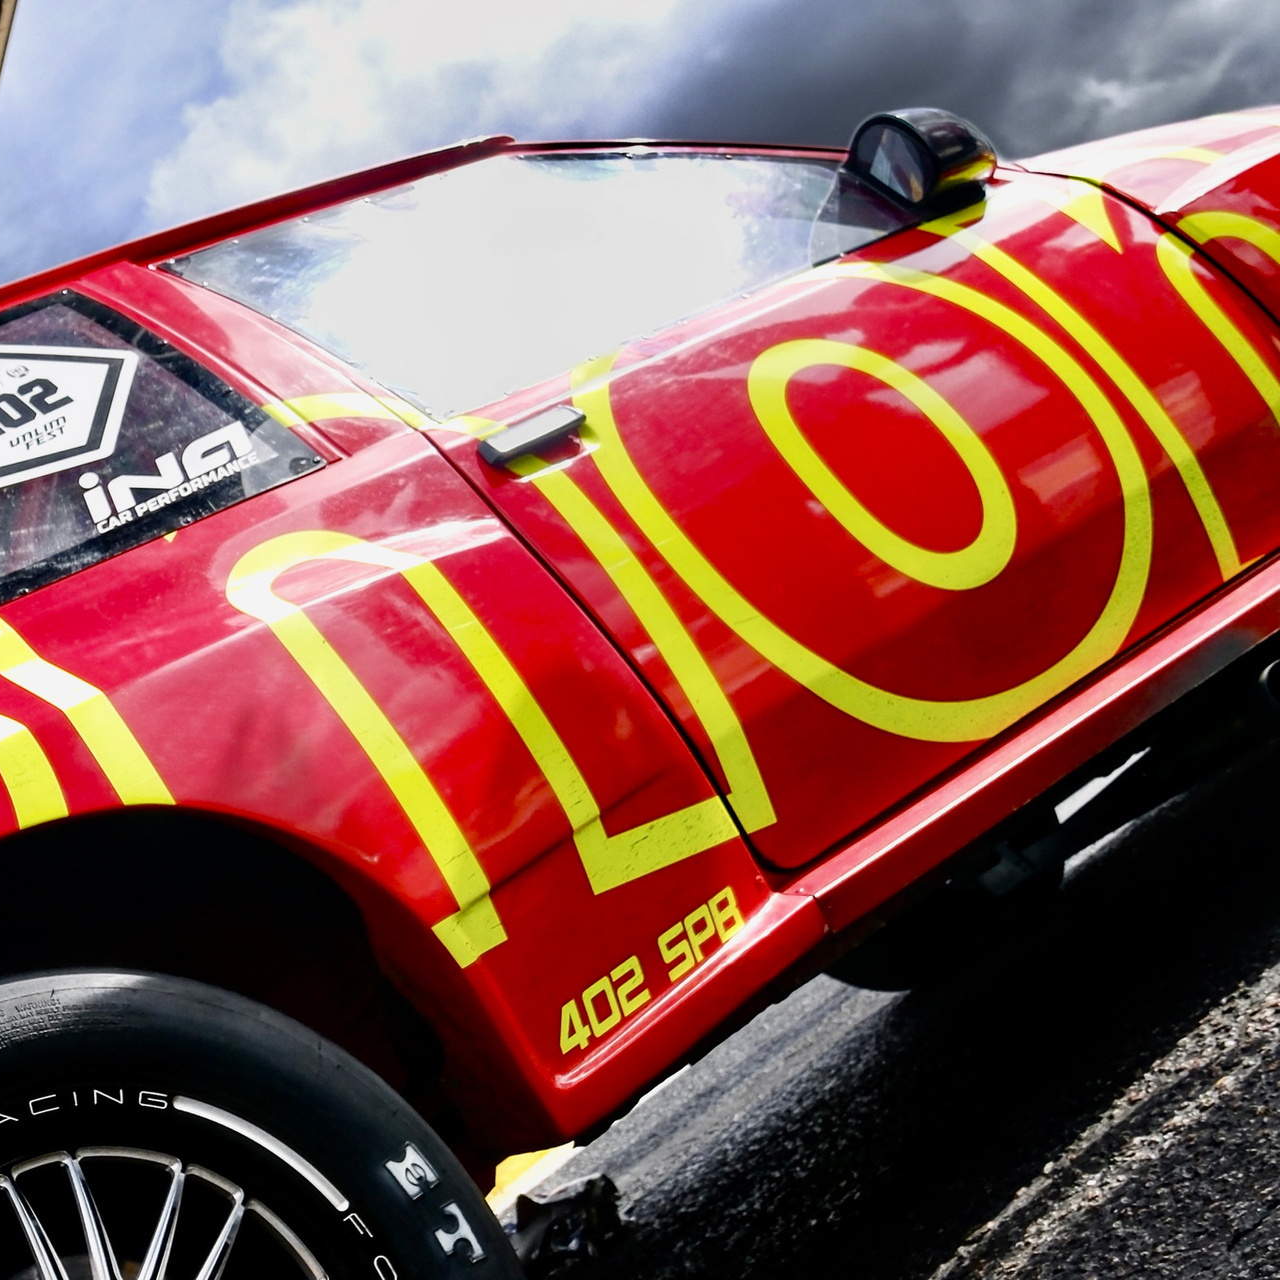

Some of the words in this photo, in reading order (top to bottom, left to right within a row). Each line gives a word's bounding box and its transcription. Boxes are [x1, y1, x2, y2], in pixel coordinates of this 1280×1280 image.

[25, 425, 66, 451] FEST
[96, 508, 135, 535] CAR
[134, 450, 261, 519] PERFORMANCE
[559, 954, 652, 1055] 402
[657, 885, 745, 983] SPB
